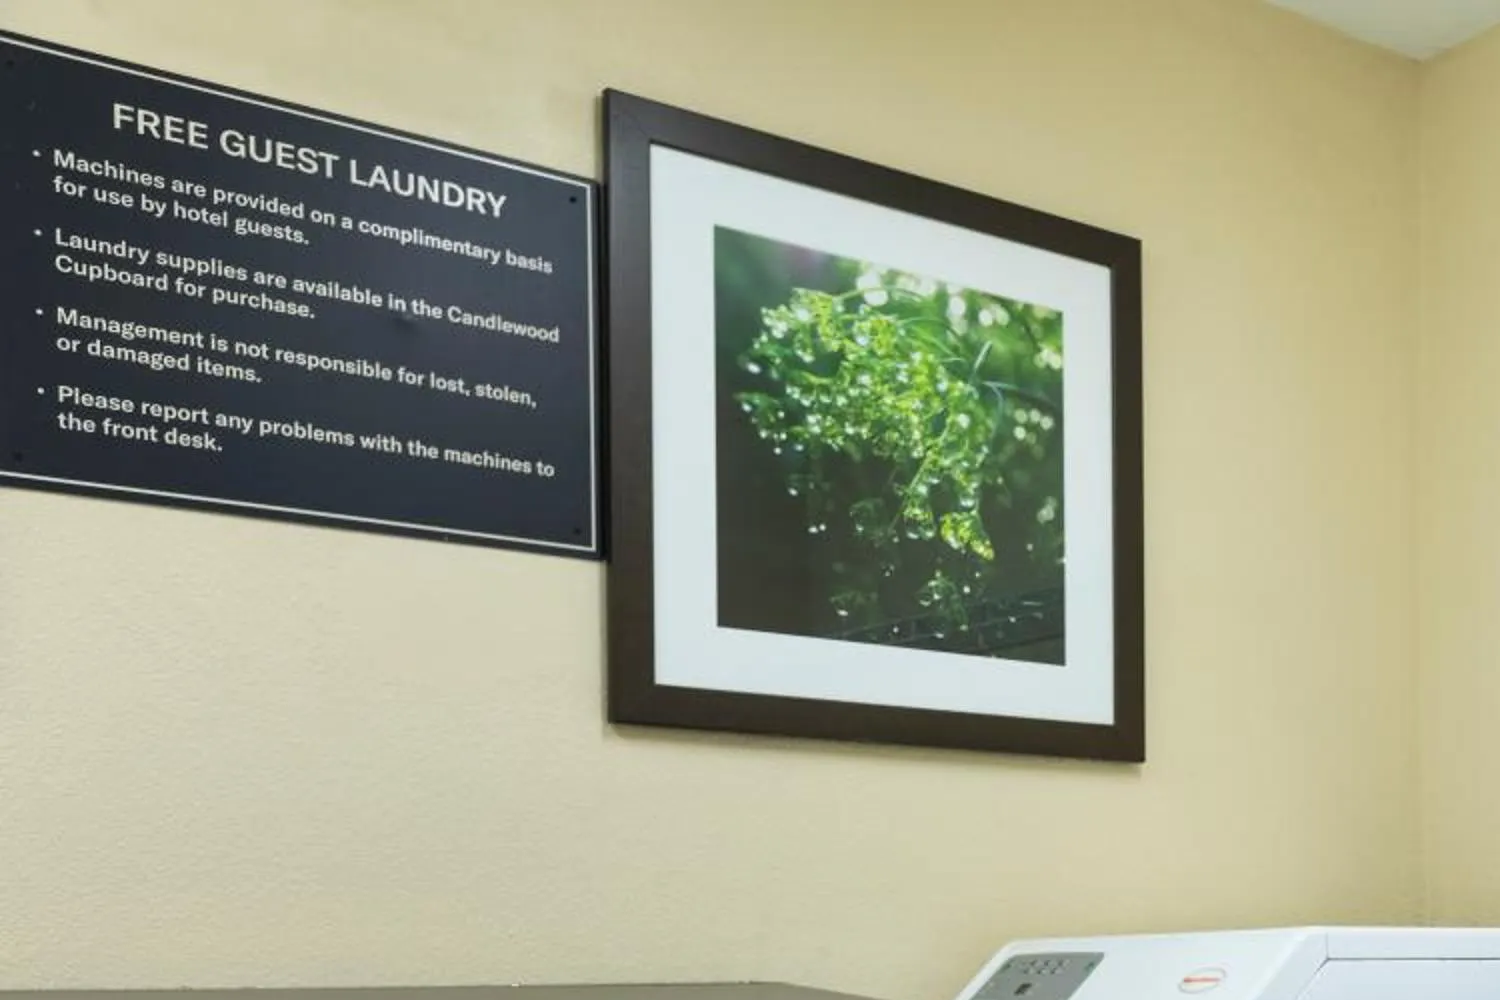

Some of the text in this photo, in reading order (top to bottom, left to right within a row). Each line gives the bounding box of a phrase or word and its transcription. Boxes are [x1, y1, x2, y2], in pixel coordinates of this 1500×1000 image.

[113, 103, 507, 217] FREE GUEST LAUNDRY
[53, 175, 309, 245] for use by hotel guests.
[53, 149, 553, 273] Machines are provided on a complimentary basis
[55, 227, 559, 343] Laundry supplies are available in the Candlewood
[55, 254, 315, 319] Cupboard for purchase.
[56, 337, 262, 383] or damaged items.
[57, 306, 537, 408] Management is not responsible for lost, stolen,
[57, 412, 223, 451] the front desk.
[58, 385, 555, 477] Please report any problems with the machines to
